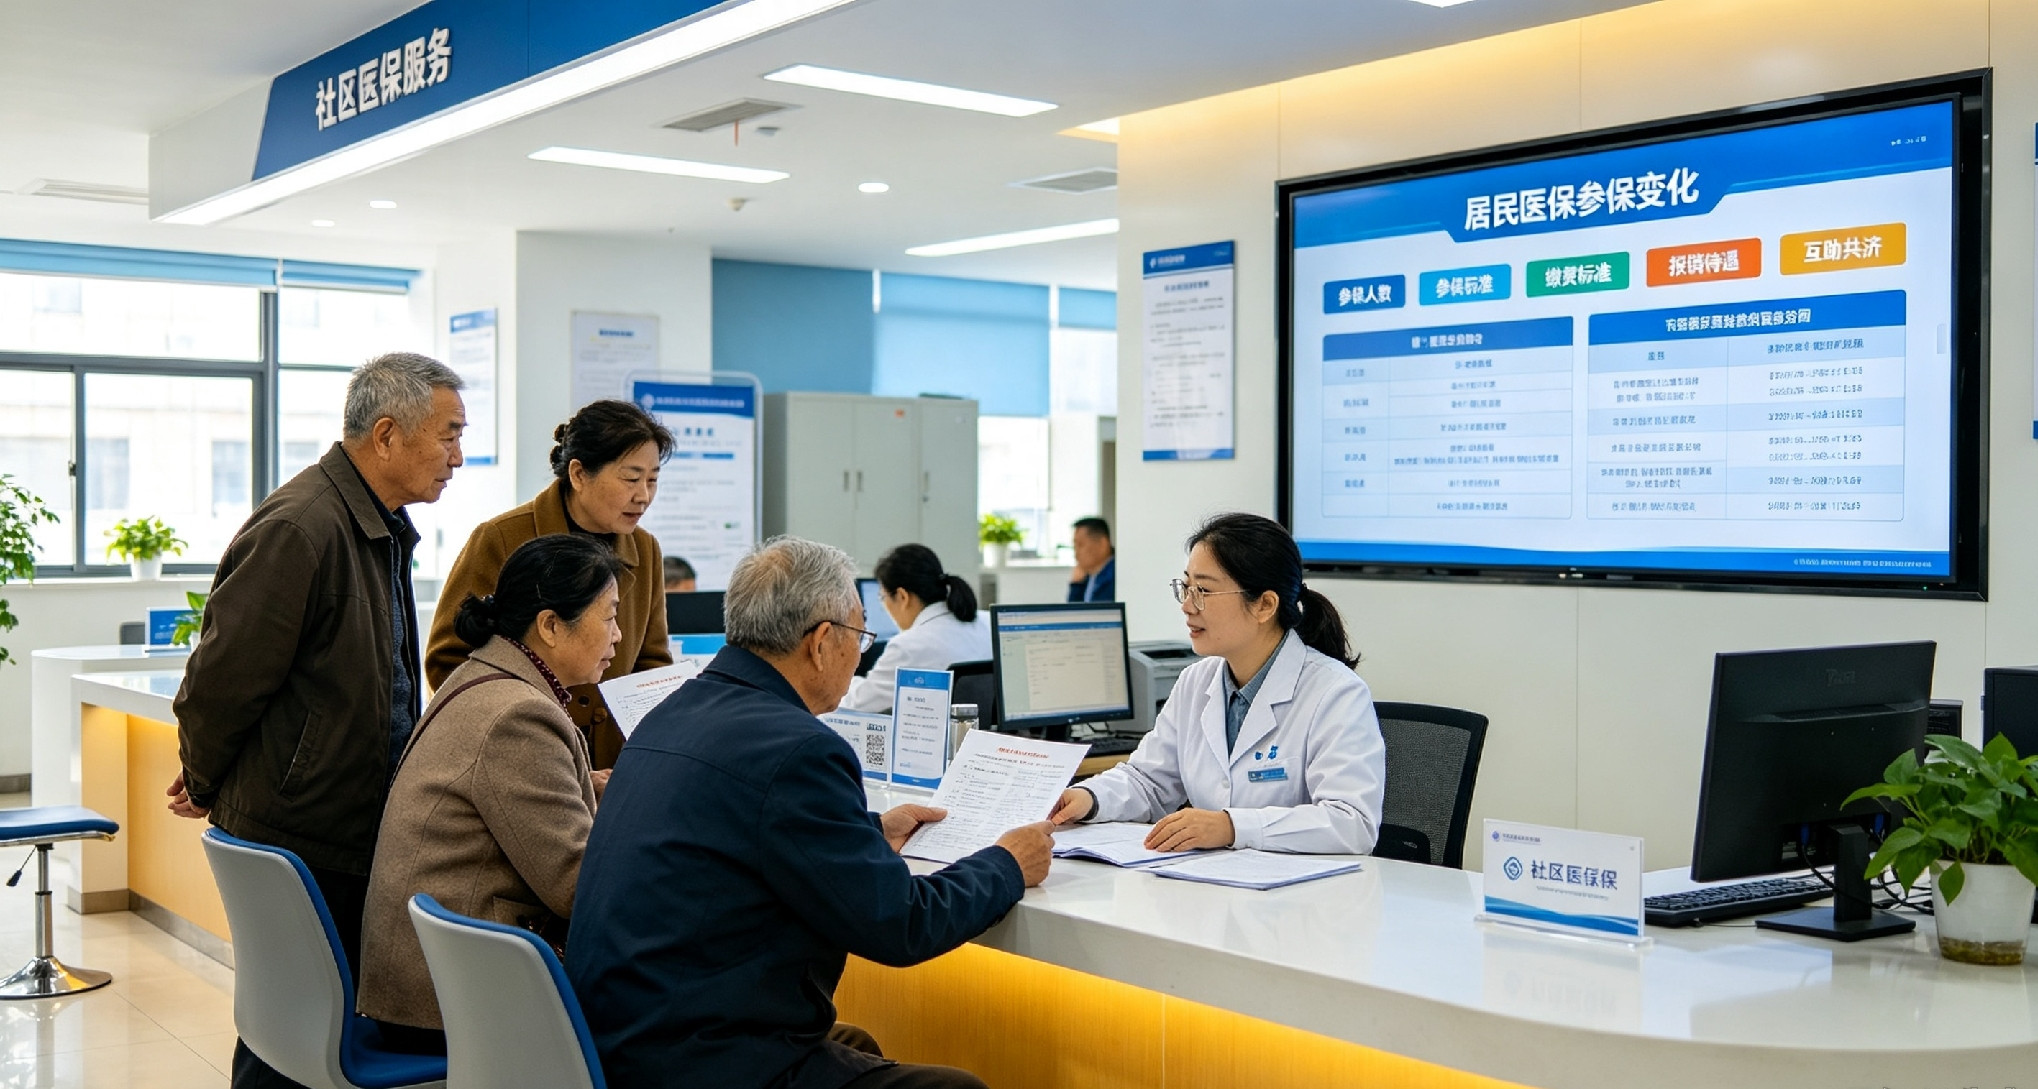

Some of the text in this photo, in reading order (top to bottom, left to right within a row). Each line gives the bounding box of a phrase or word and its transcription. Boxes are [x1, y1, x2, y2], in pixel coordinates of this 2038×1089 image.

[316, 27, 452, 131] 社区医保服务
[1464, 167, 1700, 231] 居民医保参保变化
[1803, 235, 1883, 263] 互助共济
